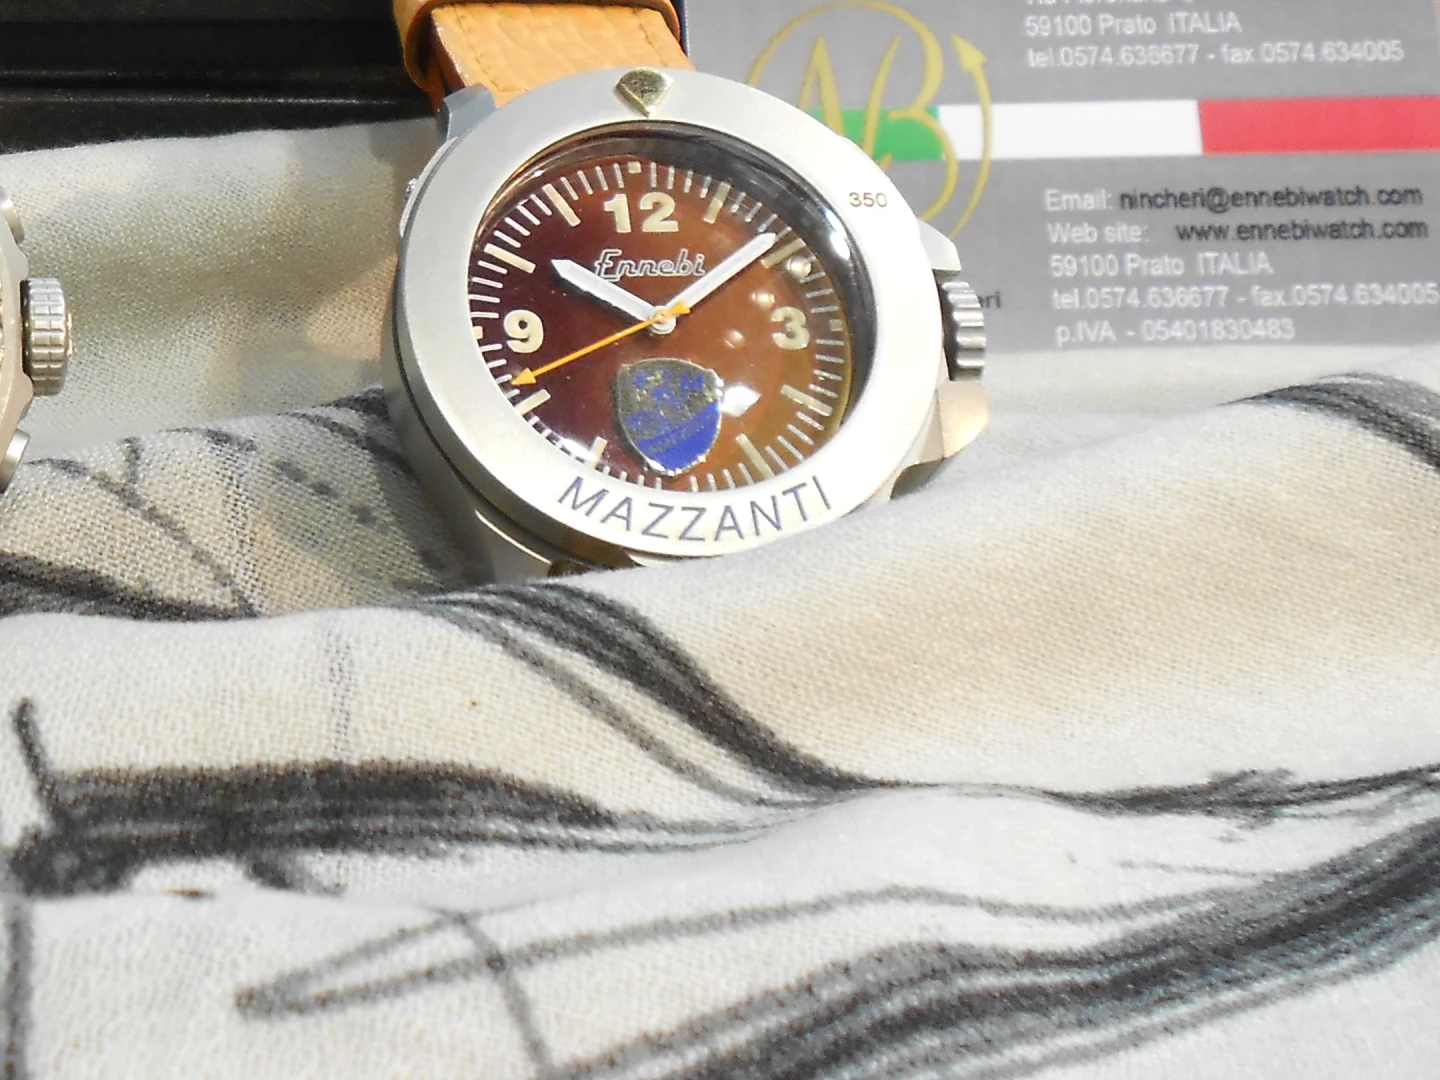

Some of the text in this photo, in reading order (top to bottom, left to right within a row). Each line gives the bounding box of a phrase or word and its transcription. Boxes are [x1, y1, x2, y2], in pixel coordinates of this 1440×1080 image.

[1025, 11, 1243, 37] 59100 Prato ITALIA
[604, 191, 679, 233] 12
[848, 192, 889, 209] 350
[1044, 186, 1424, 213] Email: nincheri@ennebiwatch.com
[1046, 219, 1430, 244] Web site: www.ennebiwatch.com
[594, 249, 706, 281] Ennebi
[1050, 251, 1274, 277] 59100 Prato ITALIA
[503, 310, 544, 353] 9
[771, 307, 810, 350] 3
[1055, 321, 1117, 347] p.IVA
[1143, 318, 1296, 342] 05401830483
[559, 475, 832, 542] MAZZANTI
